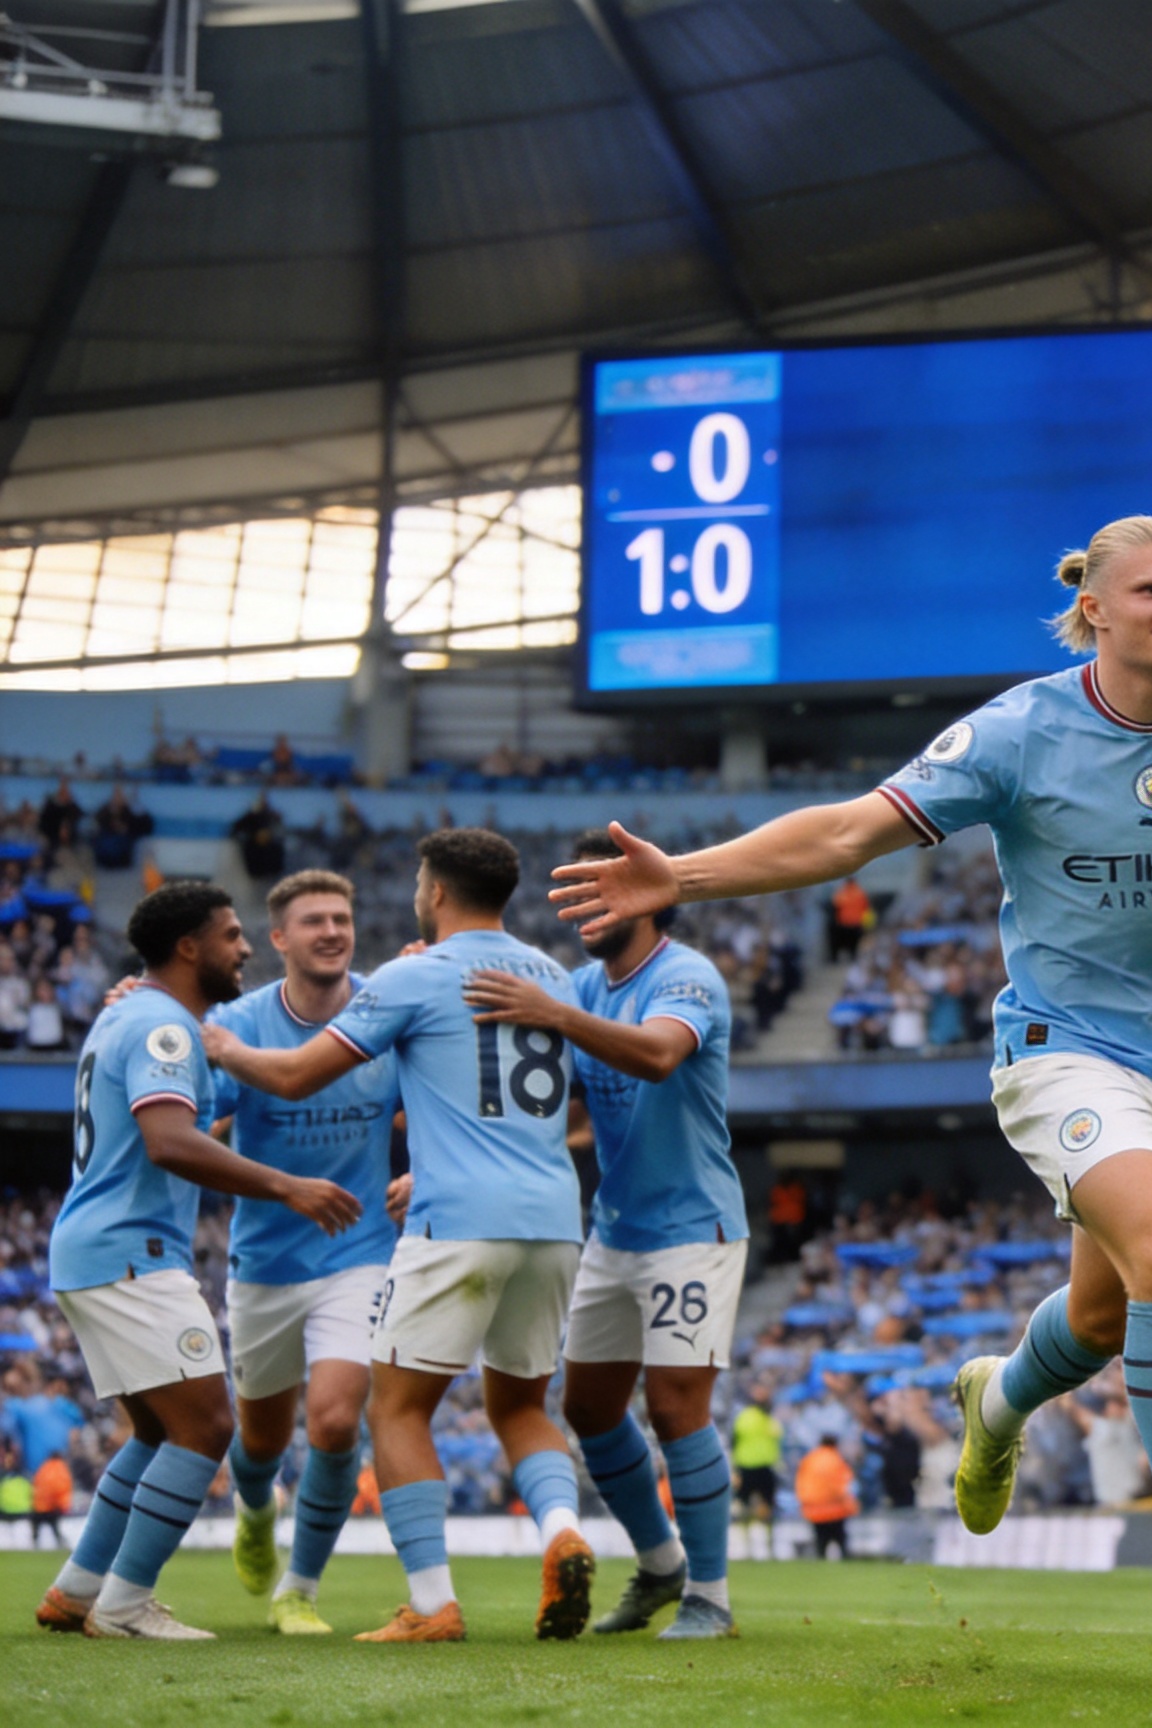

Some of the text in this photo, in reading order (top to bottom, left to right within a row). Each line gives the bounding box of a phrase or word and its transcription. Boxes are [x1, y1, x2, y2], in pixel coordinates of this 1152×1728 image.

[625, 523, 752, 615] 1:0
[477, 1022, 566, 1118] 18
[650, 1281, 707, 1328] 26
